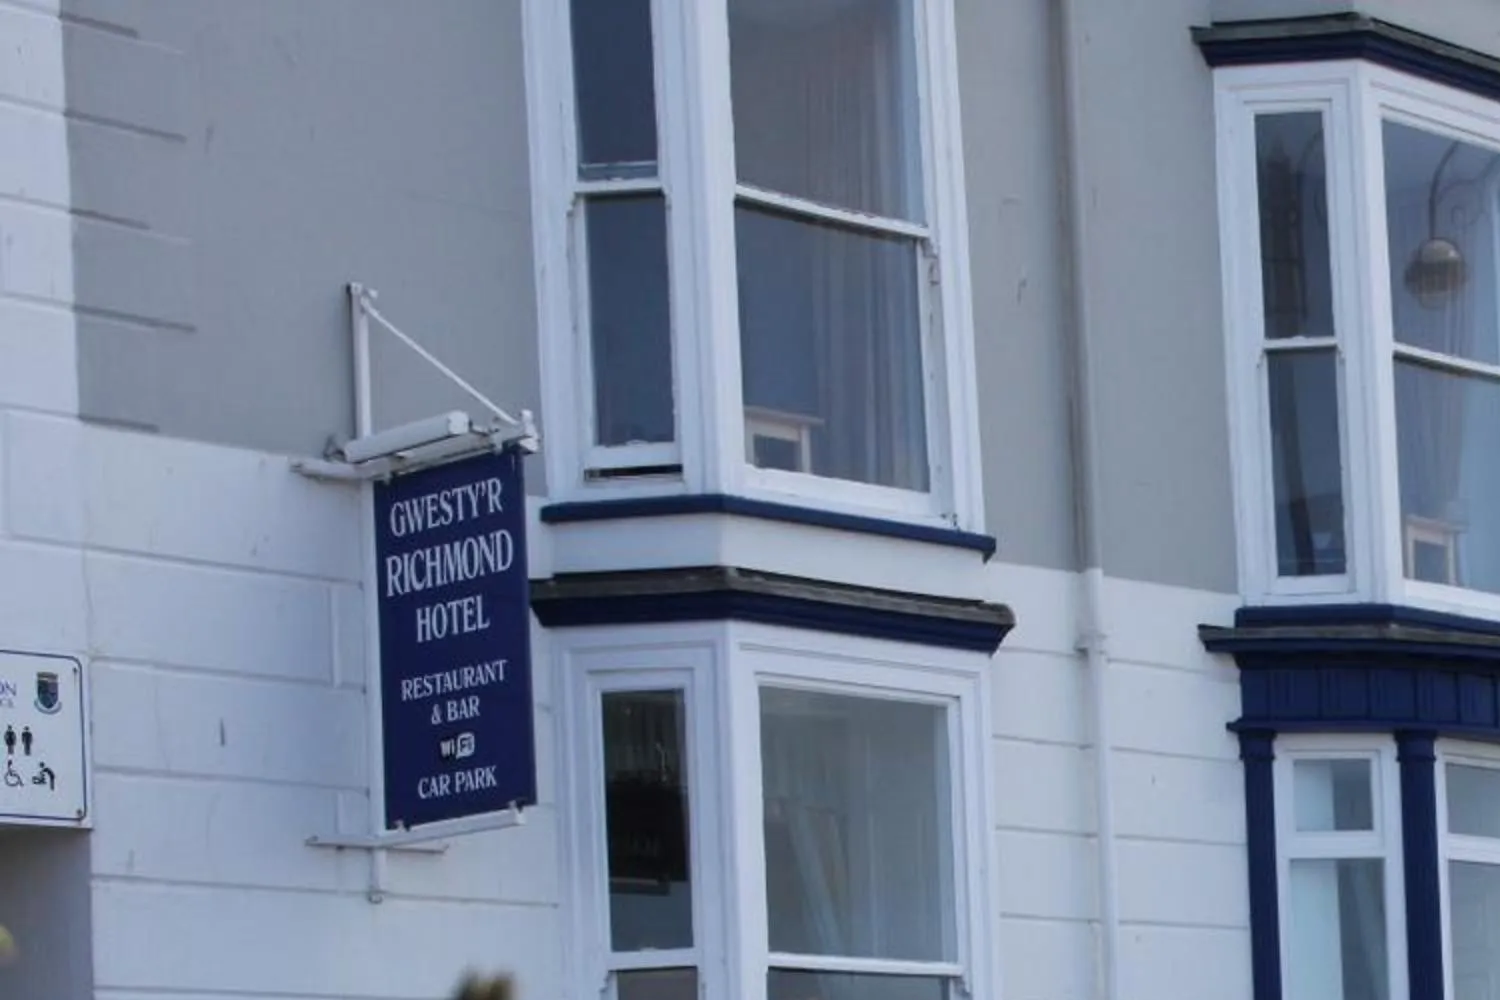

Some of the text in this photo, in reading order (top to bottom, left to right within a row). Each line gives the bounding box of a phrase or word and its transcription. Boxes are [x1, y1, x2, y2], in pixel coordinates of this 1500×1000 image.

[390, 477, 503, 537] GWESTY'R
[386, 529, 513, 597] RICHMOND
[416, 594, 490, 643] HOTEL
[401, 659, 508, 701] RESTAURANT
[430, 696, 481, 725] & BAR
[418, 765, 498, 799] CAR PARK
